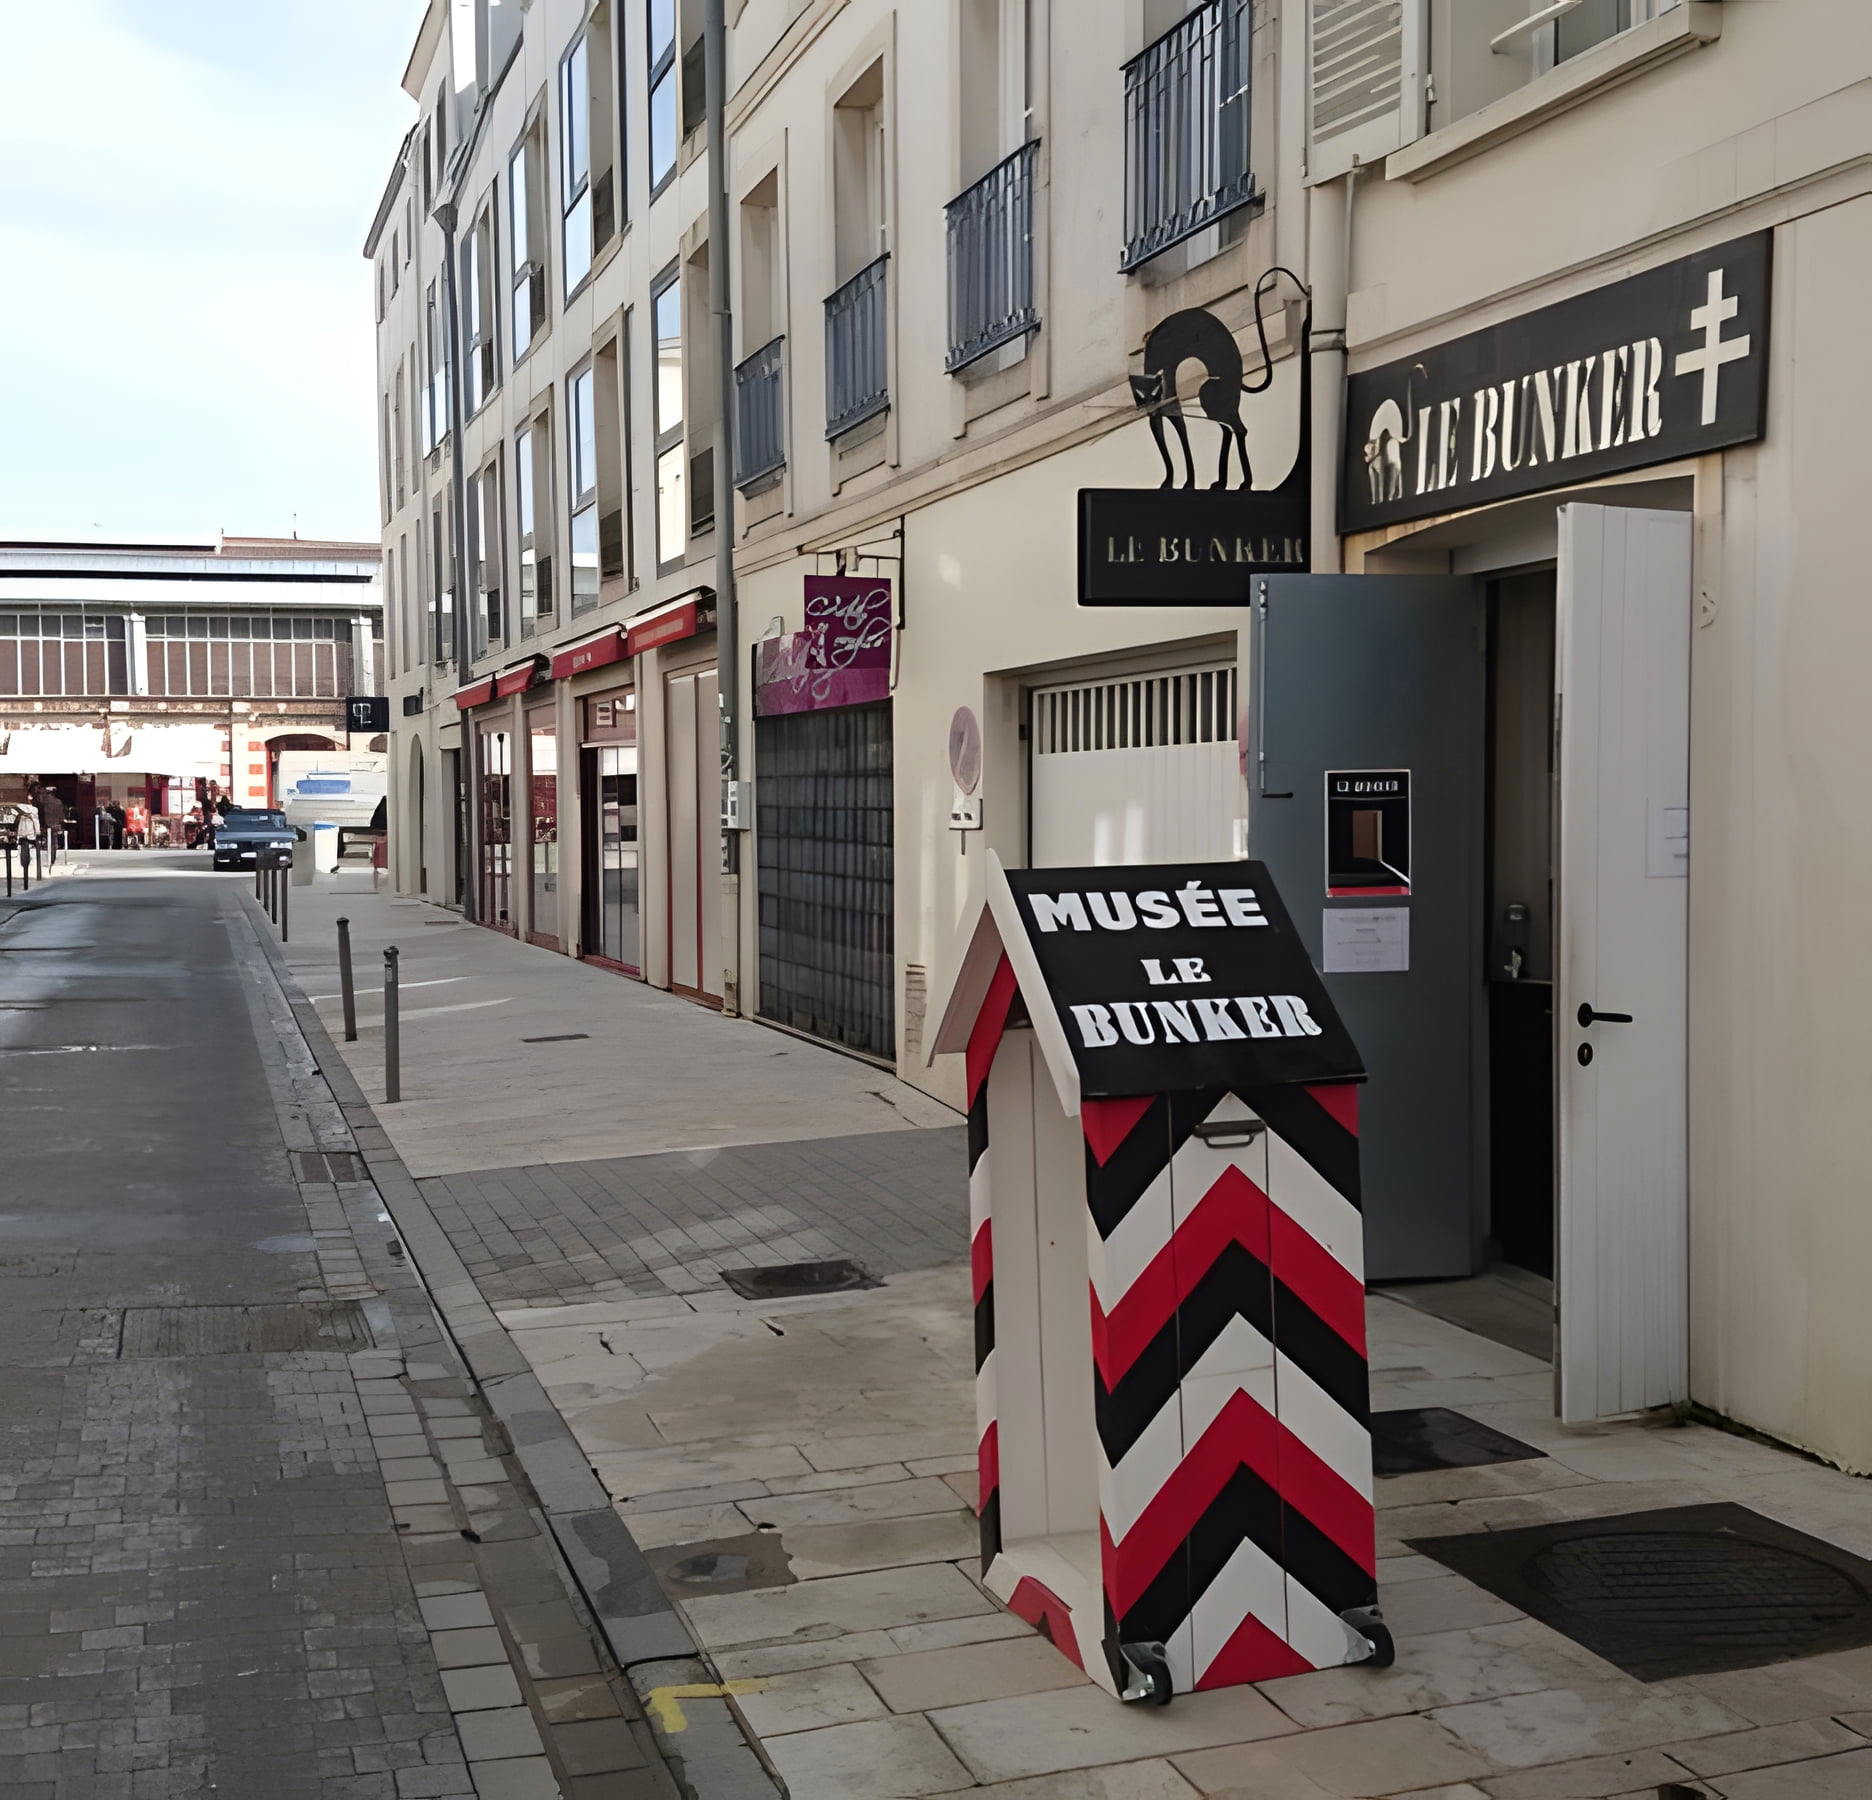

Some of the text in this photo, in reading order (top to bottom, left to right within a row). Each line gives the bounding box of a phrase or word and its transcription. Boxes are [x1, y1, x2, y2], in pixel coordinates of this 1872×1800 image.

[1416, 336, 1663, 495] LE BUNKER
[1107, 536, 1303, 563] LE BUNKER
[1028, 880, 1269, 933] MUSÉE
[1140, 957, 1212, 985] LE
[1069, 995, 1323, 1048] BUNKER
